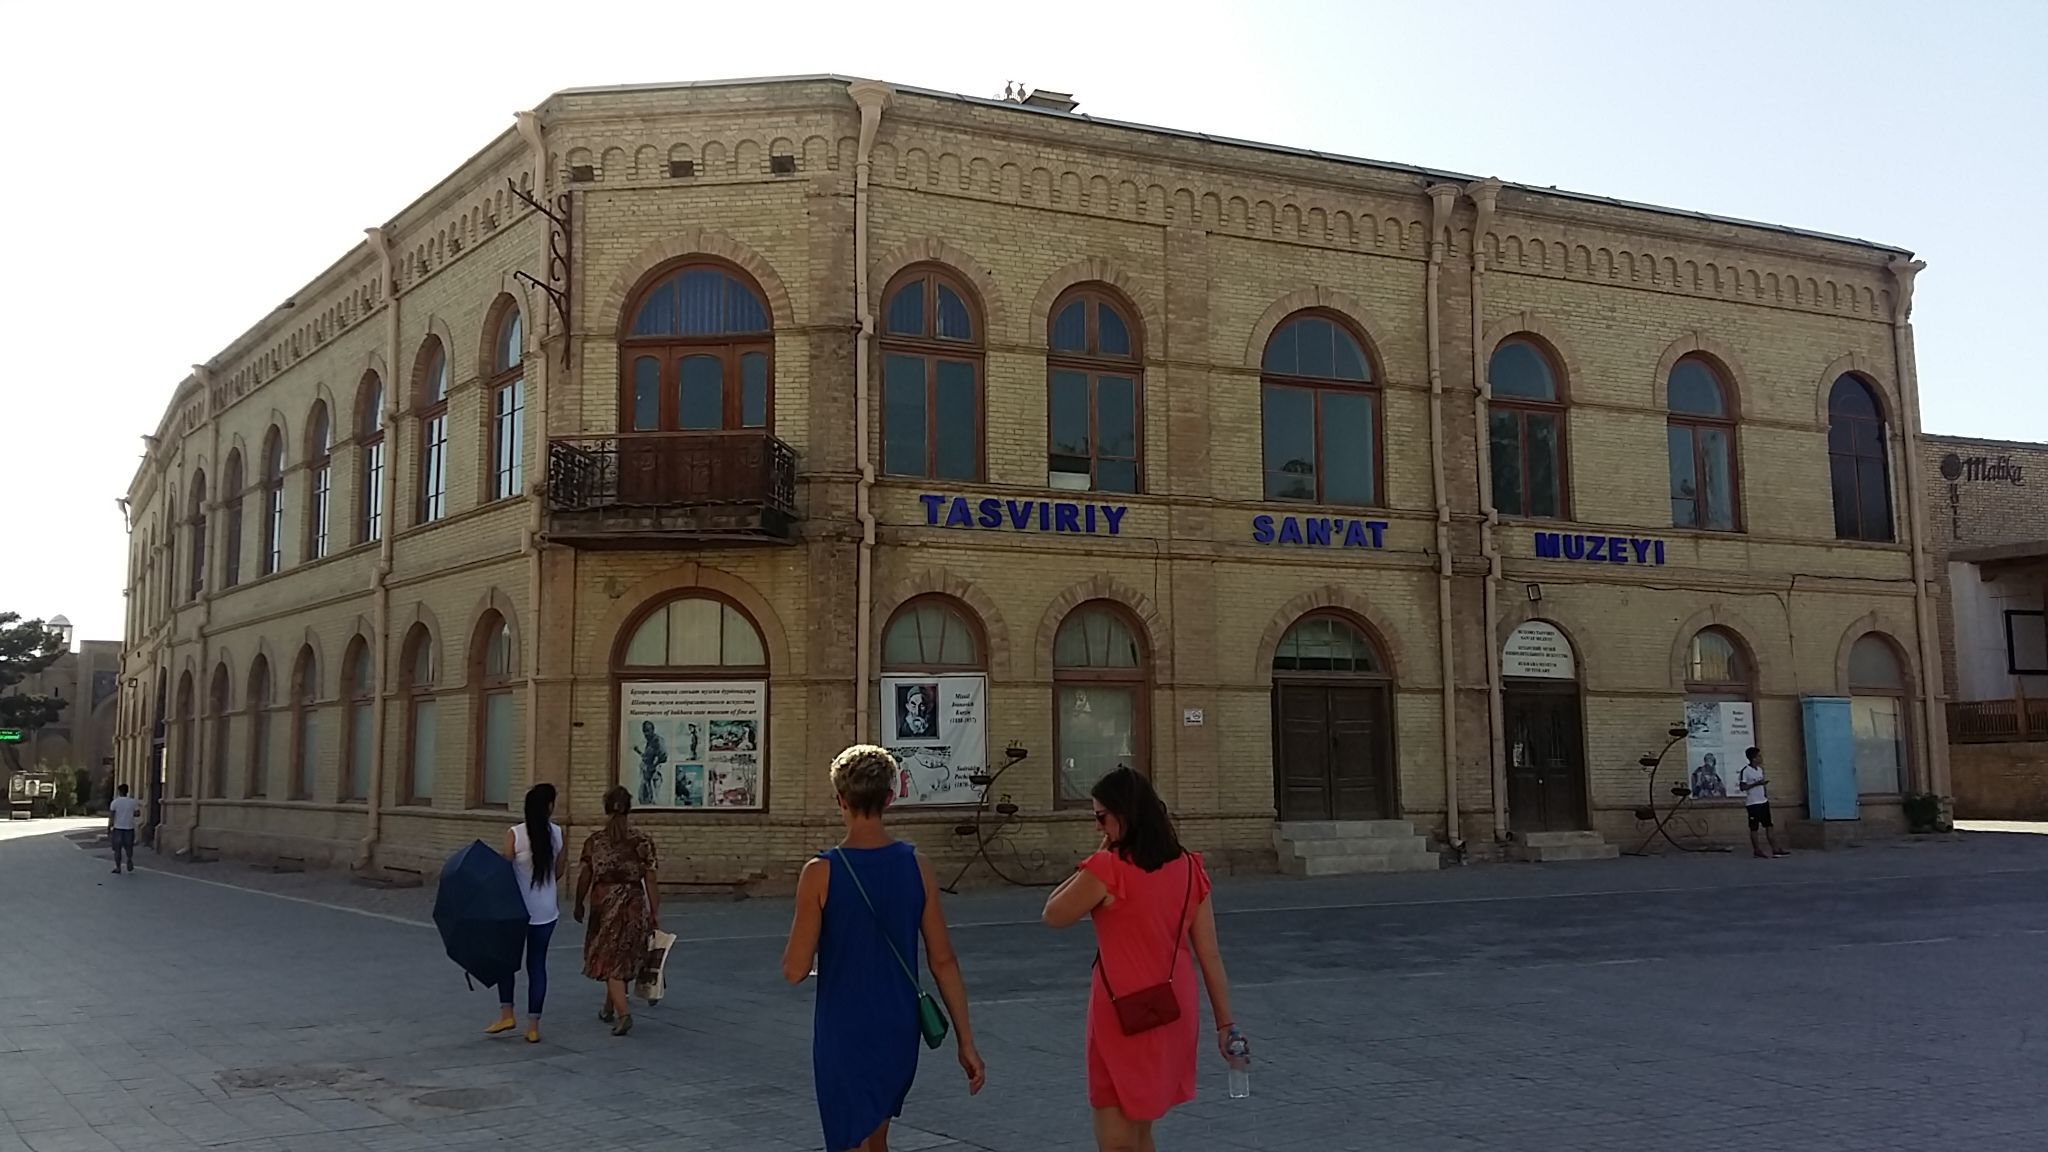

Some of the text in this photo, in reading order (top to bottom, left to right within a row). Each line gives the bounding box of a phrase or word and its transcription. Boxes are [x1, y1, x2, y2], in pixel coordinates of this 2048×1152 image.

[1962, 455, 2026, 487] Malika
[919, 494, 1128, 535] TASVIRIY
[1534, 532, 1665, 565] MUZEYI
